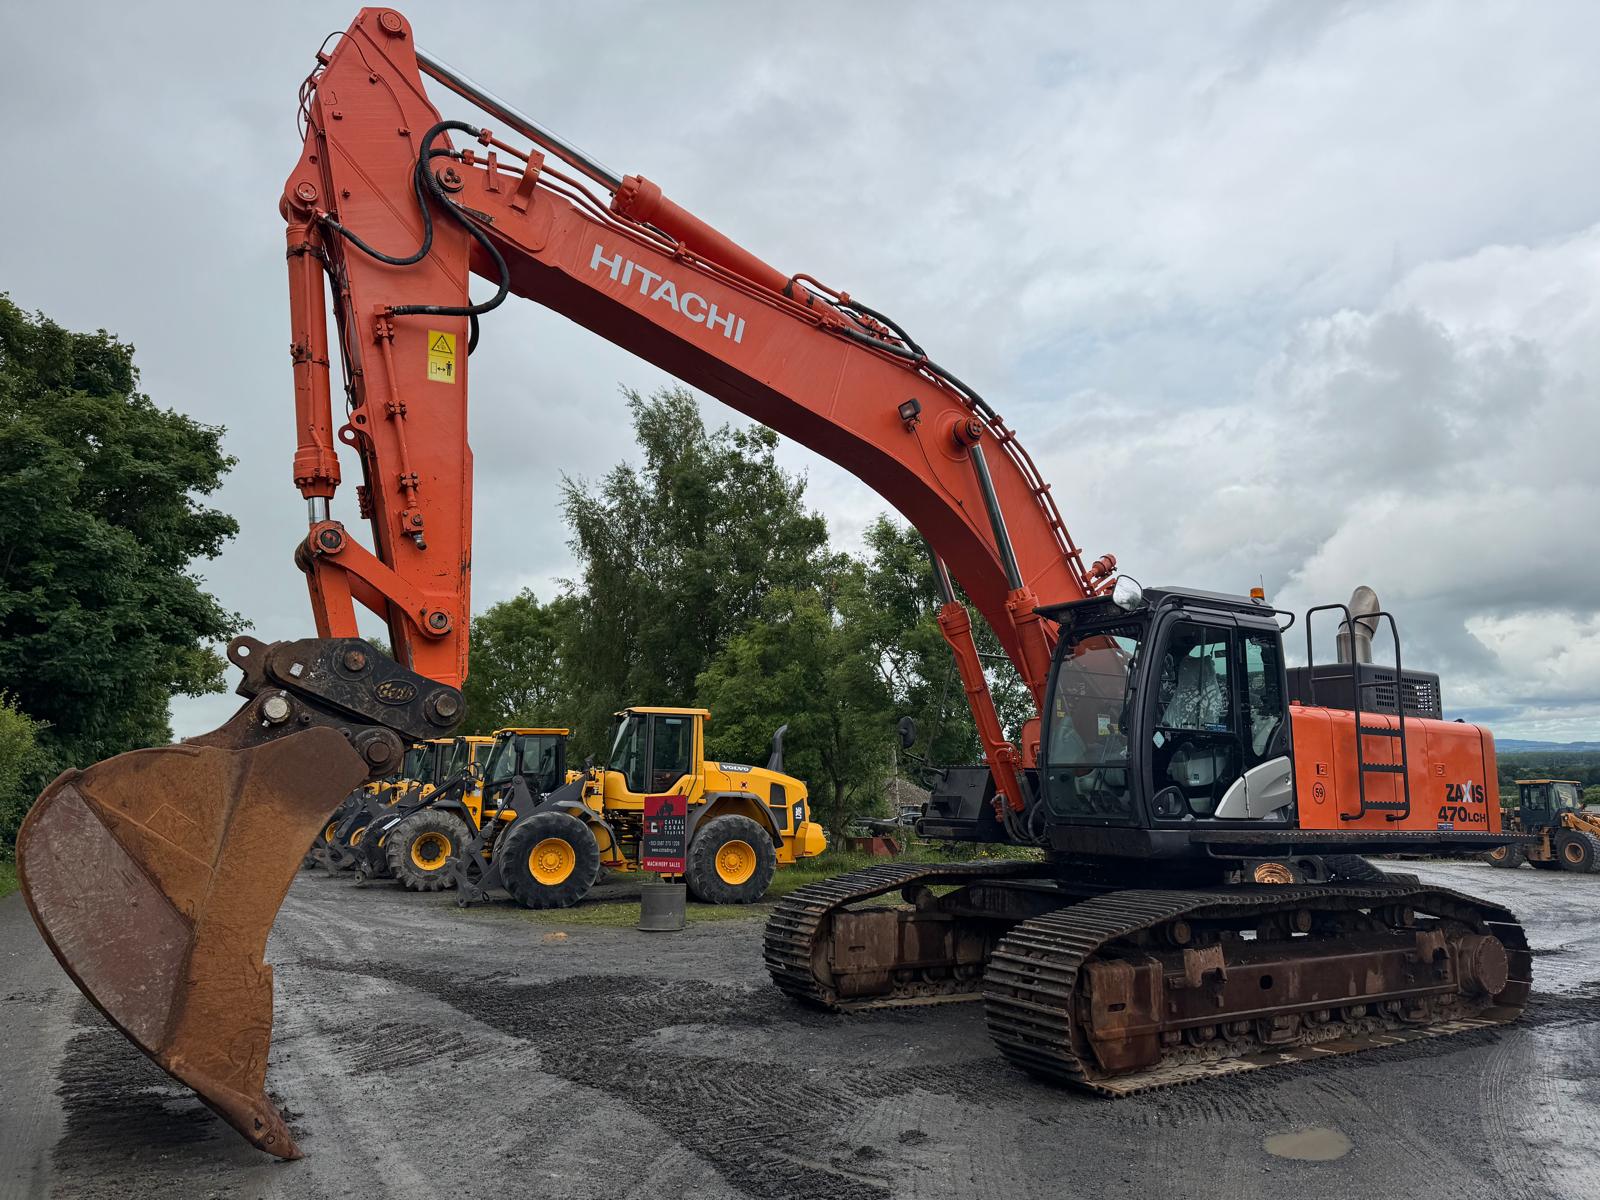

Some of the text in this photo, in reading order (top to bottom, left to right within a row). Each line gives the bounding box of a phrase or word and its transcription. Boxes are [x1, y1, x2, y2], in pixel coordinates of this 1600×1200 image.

[590, 243, 746, 344] HITACHI
[721, 764, 750, 772] VOLVO
[1315, 787, 1324, 798] 59
[1445, 780, 1484, 803] ZAXIS
[1438, 805, 1486, 822] 470LCH
